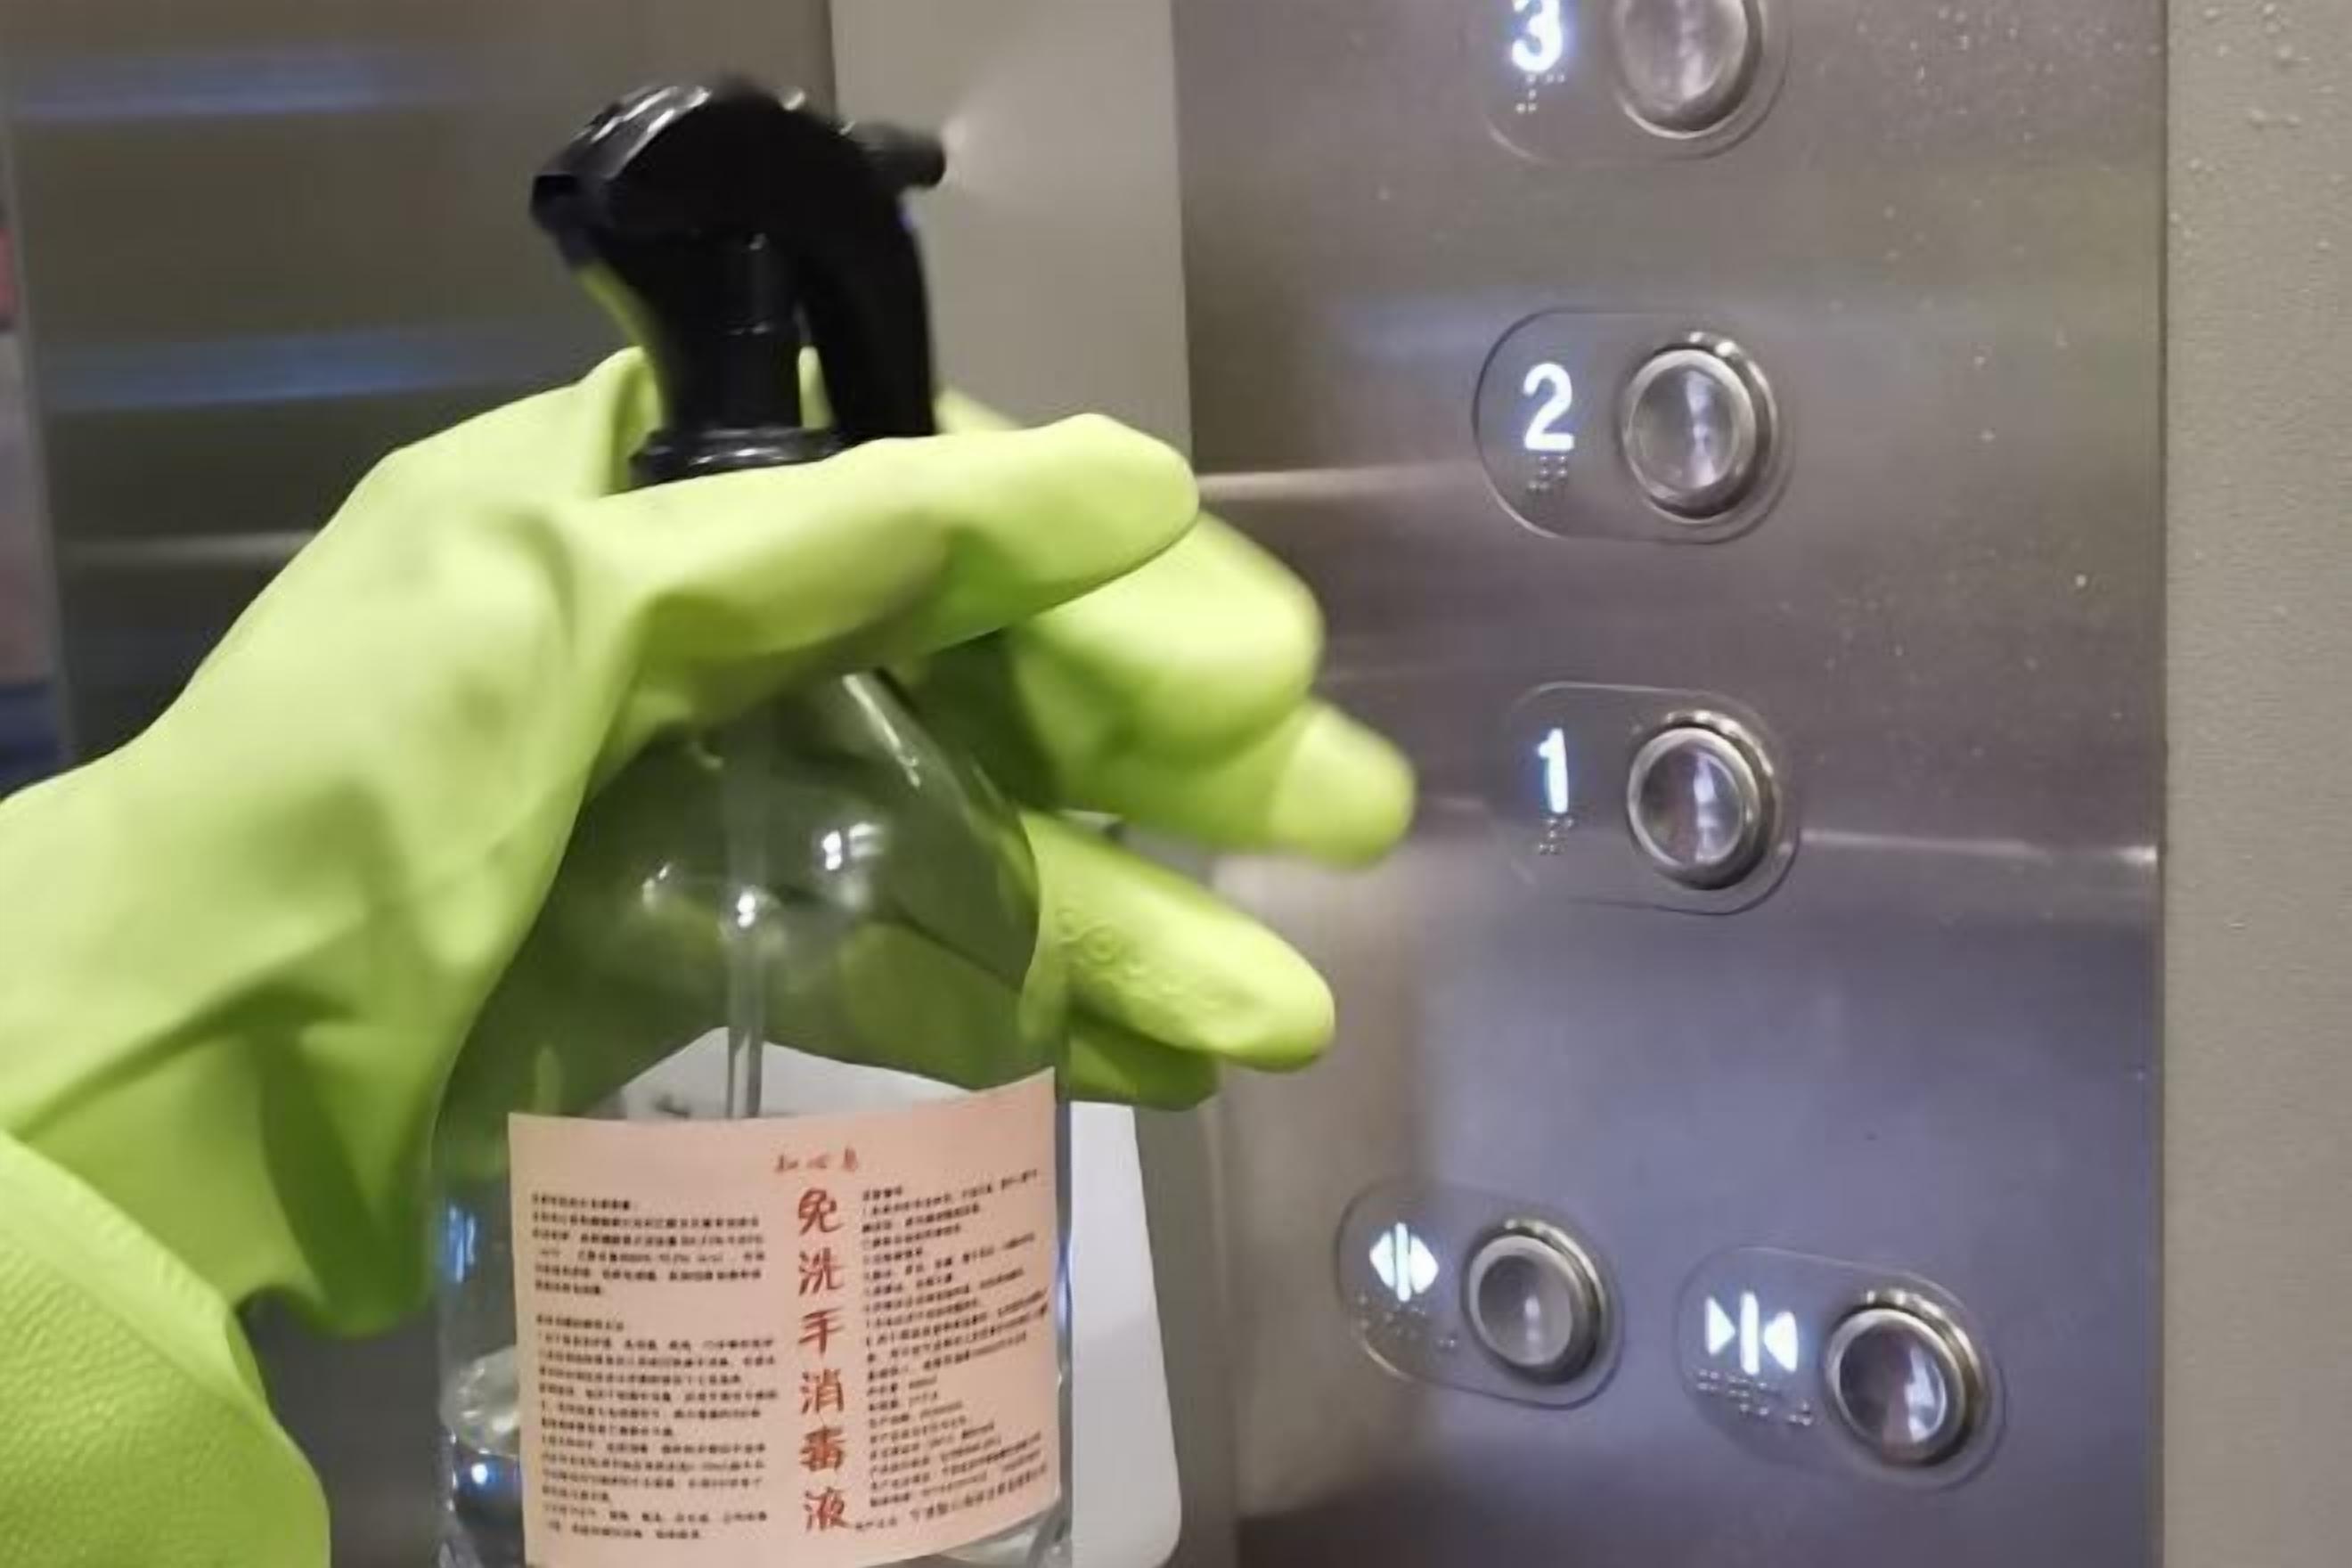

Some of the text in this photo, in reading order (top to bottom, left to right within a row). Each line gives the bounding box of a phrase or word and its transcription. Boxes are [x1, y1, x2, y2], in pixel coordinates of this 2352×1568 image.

[1511, 0, 1563, 71] 3
[1523, 362, 1574, 450] 2
[1538, 728, 1568, 813] 1
[797, 1187, 850, 1534] 免洗手消毒液
